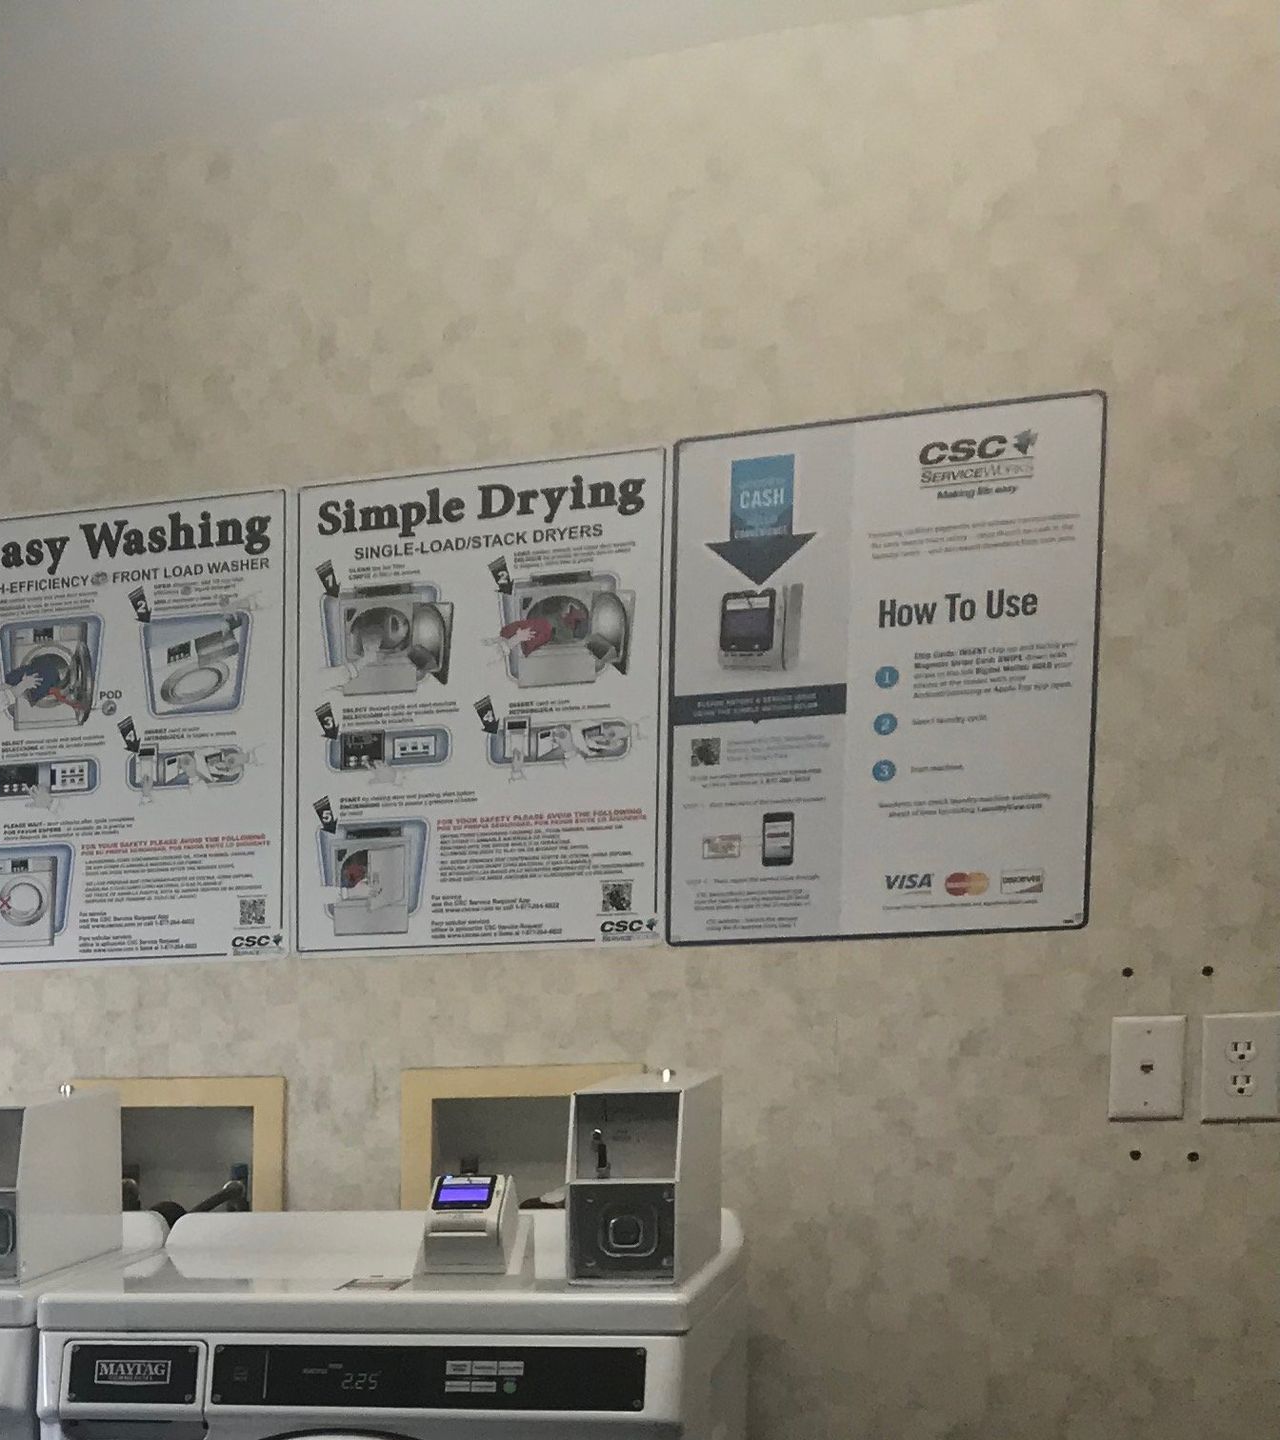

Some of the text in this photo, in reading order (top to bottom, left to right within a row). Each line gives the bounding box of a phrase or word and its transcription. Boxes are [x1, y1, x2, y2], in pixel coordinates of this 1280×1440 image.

[919, 435, 1008, 465] CSC
[740, 488, 785, 509] CASH
[317, 474, 646, 538] Simple Drying
[79, 511, 271, 559] Washing
[354, 531, 527, 561] SINGLE-LOAD/STACK
[532, 523, 603, 543] DRYERS
[112, 568, 159, 584] FRONT
[164, 564, 203, 578] LOAD
[208, 557, 270, 574] WASHER
[497, 570, 509, 583] 2
[325, 575, 333, 587] 1
[136, 600, 147, 613] 2
[878, 588, 1038, 628] How To Use
[100, 690, 122, 700] POD
[323, 716, 334, 729] 3
[483, 711, 493, 723] 4
[322, 810, 332, 823] 5
[884, 873, 932, 890] VISA
[600, 919, 644, 933] CSC
[231, 935, 270, 948] CSC
[99, 1363, 165, 1376] MAYTAG
[341, 1373, 378, 1390] 2.25
